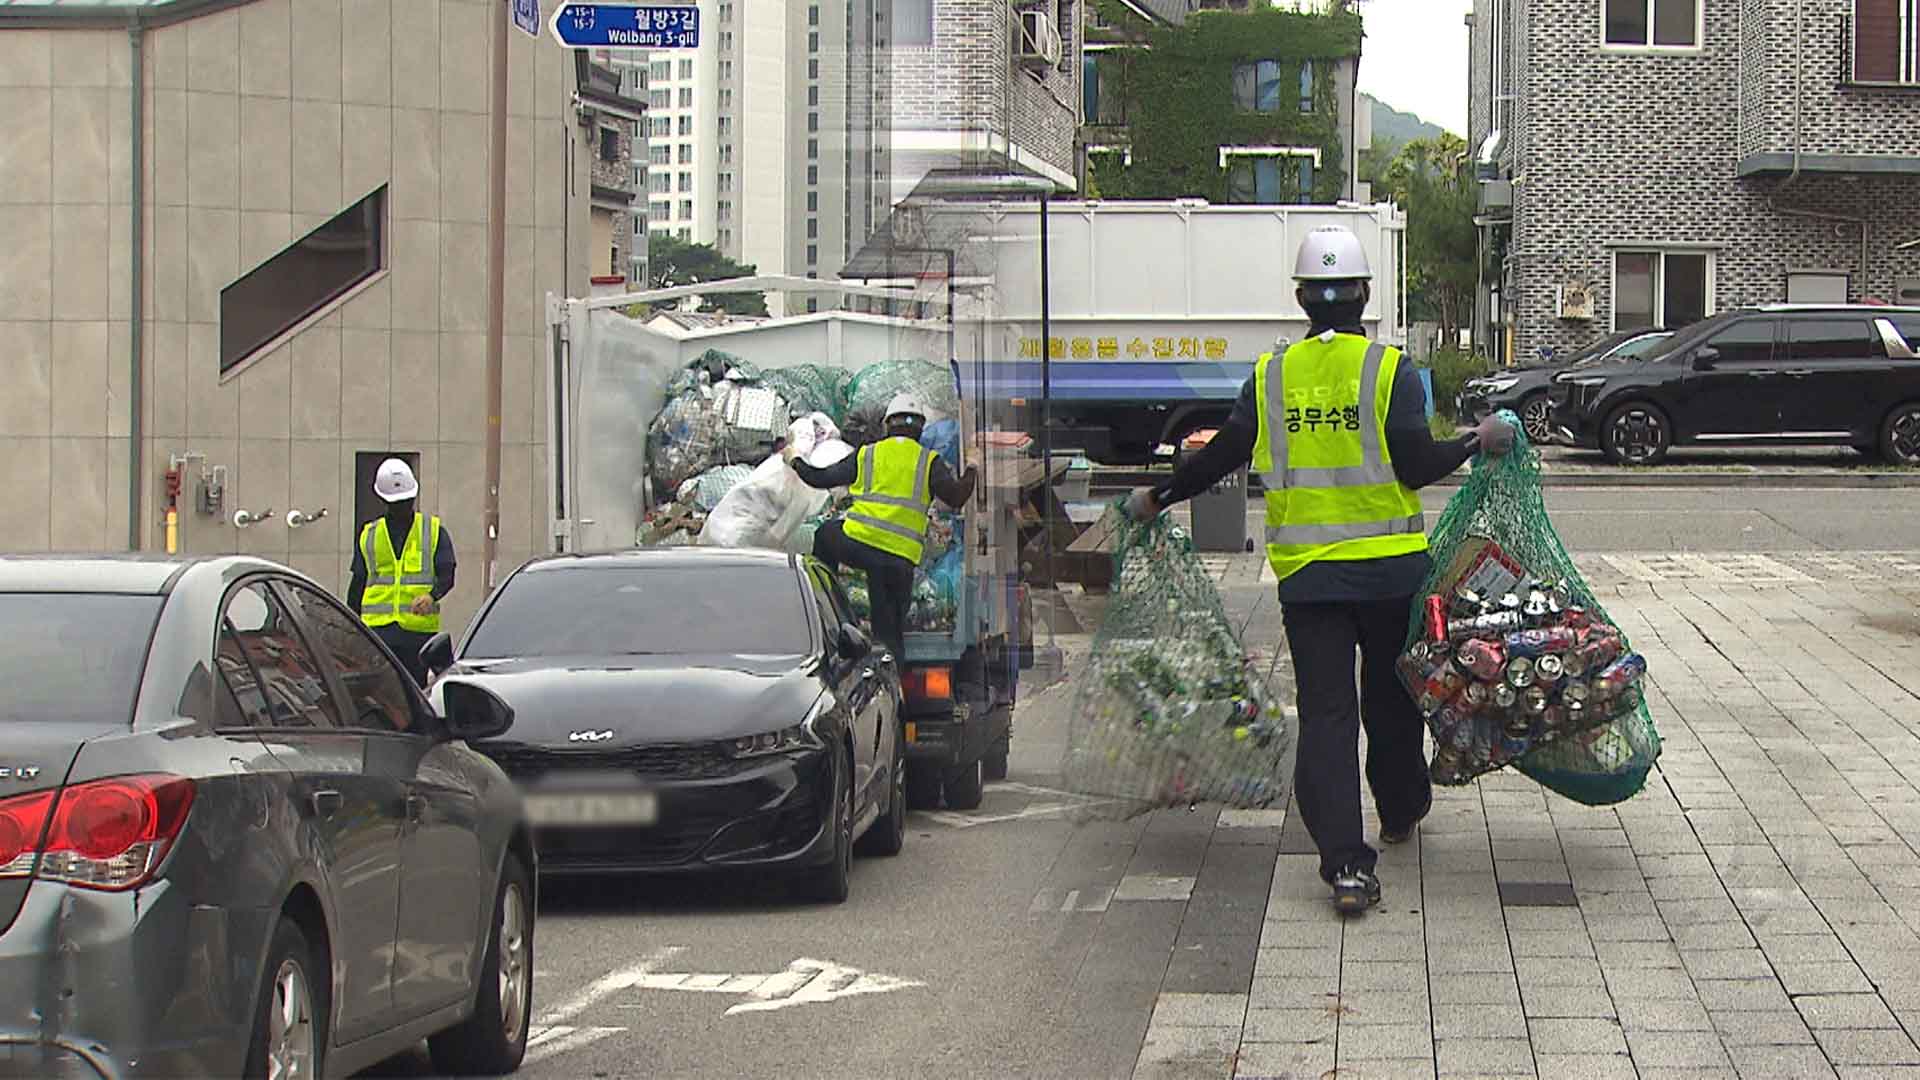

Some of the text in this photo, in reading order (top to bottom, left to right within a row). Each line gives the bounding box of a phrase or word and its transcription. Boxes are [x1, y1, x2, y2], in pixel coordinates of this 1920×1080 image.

[575, 7, 595, 17] 15-1
[634, 8, 696, 30] 월방3길
[573, 18, 595, 29] 15-7
[608, 29, 694, 47] Wolbang 3-gil
[1017, 336, 1229, 359] 재활용품 수집차량
[1285, 405, 1360, 432] 공무수행
